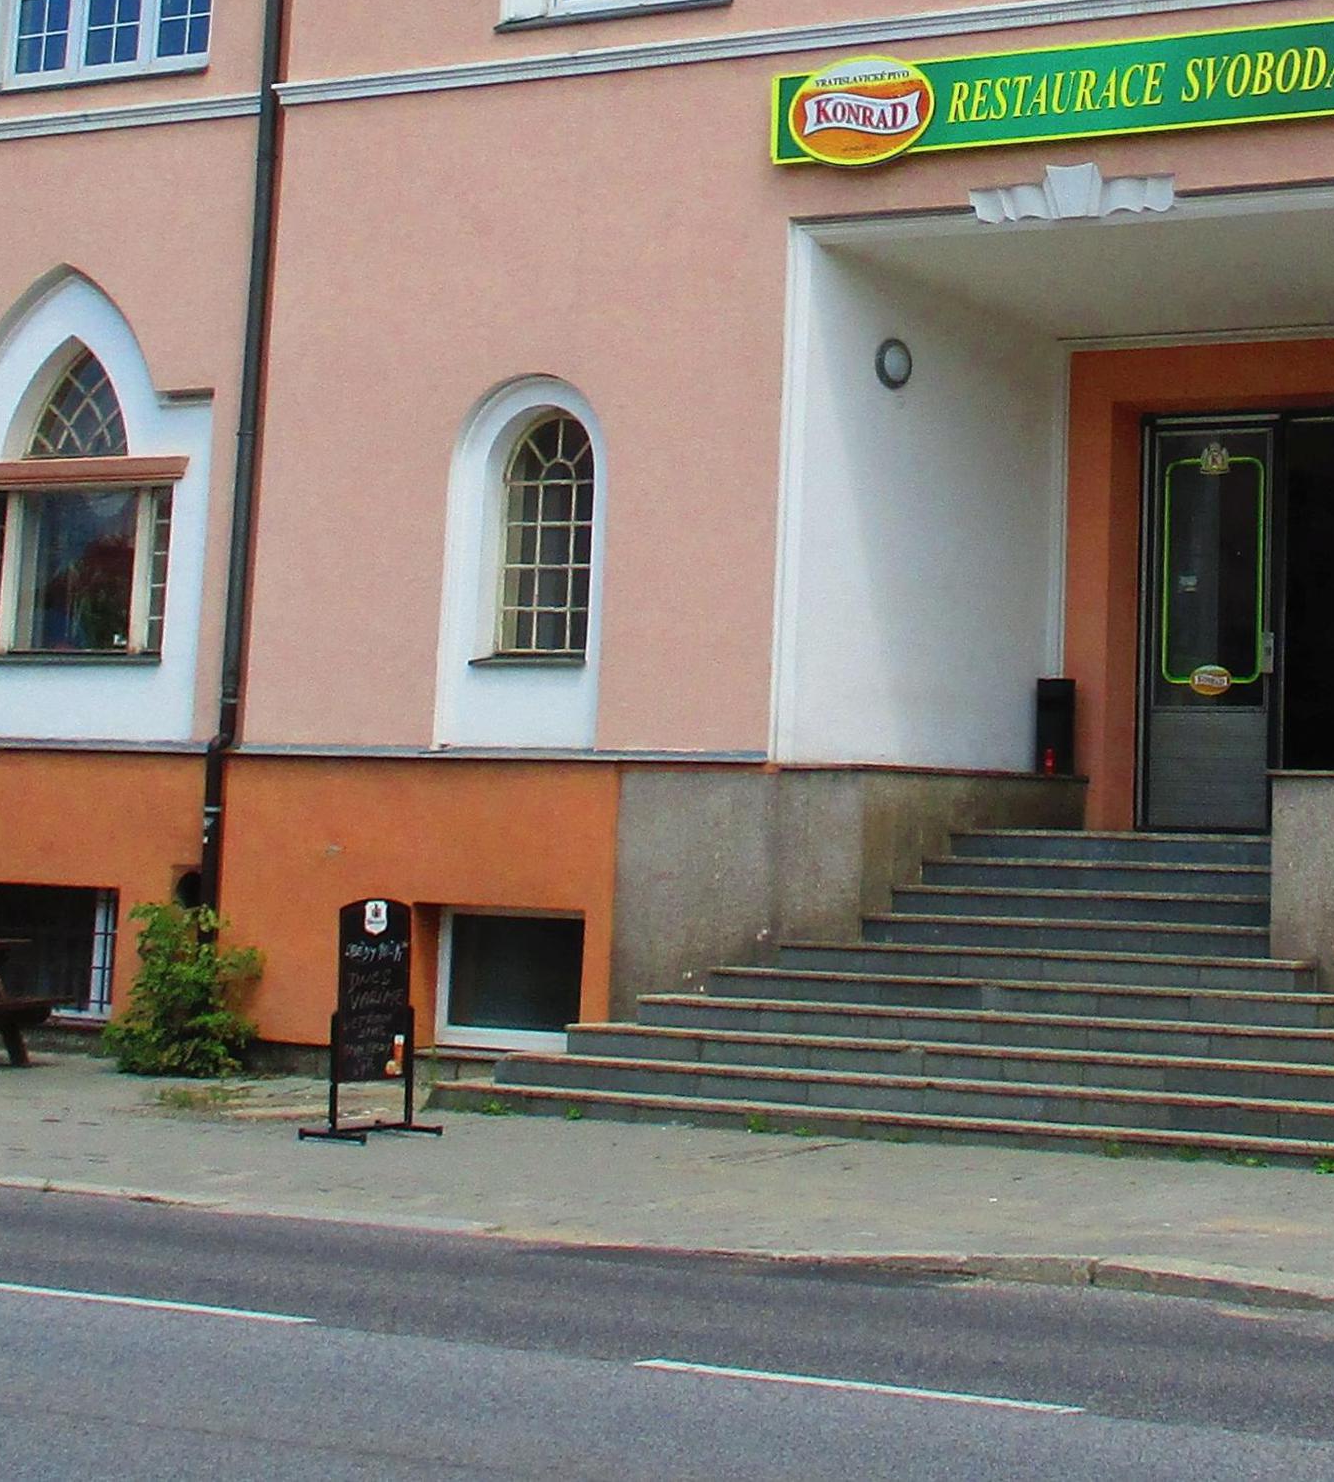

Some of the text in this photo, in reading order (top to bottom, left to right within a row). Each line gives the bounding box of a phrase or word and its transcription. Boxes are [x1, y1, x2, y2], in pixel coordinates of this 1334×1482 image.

[815, 70, 910, 88] VRATISLAVICKÉ PIVO
[947, 62, 1166, 124] RESTAURACE
[814, 97, 909, 130] KONRAD
